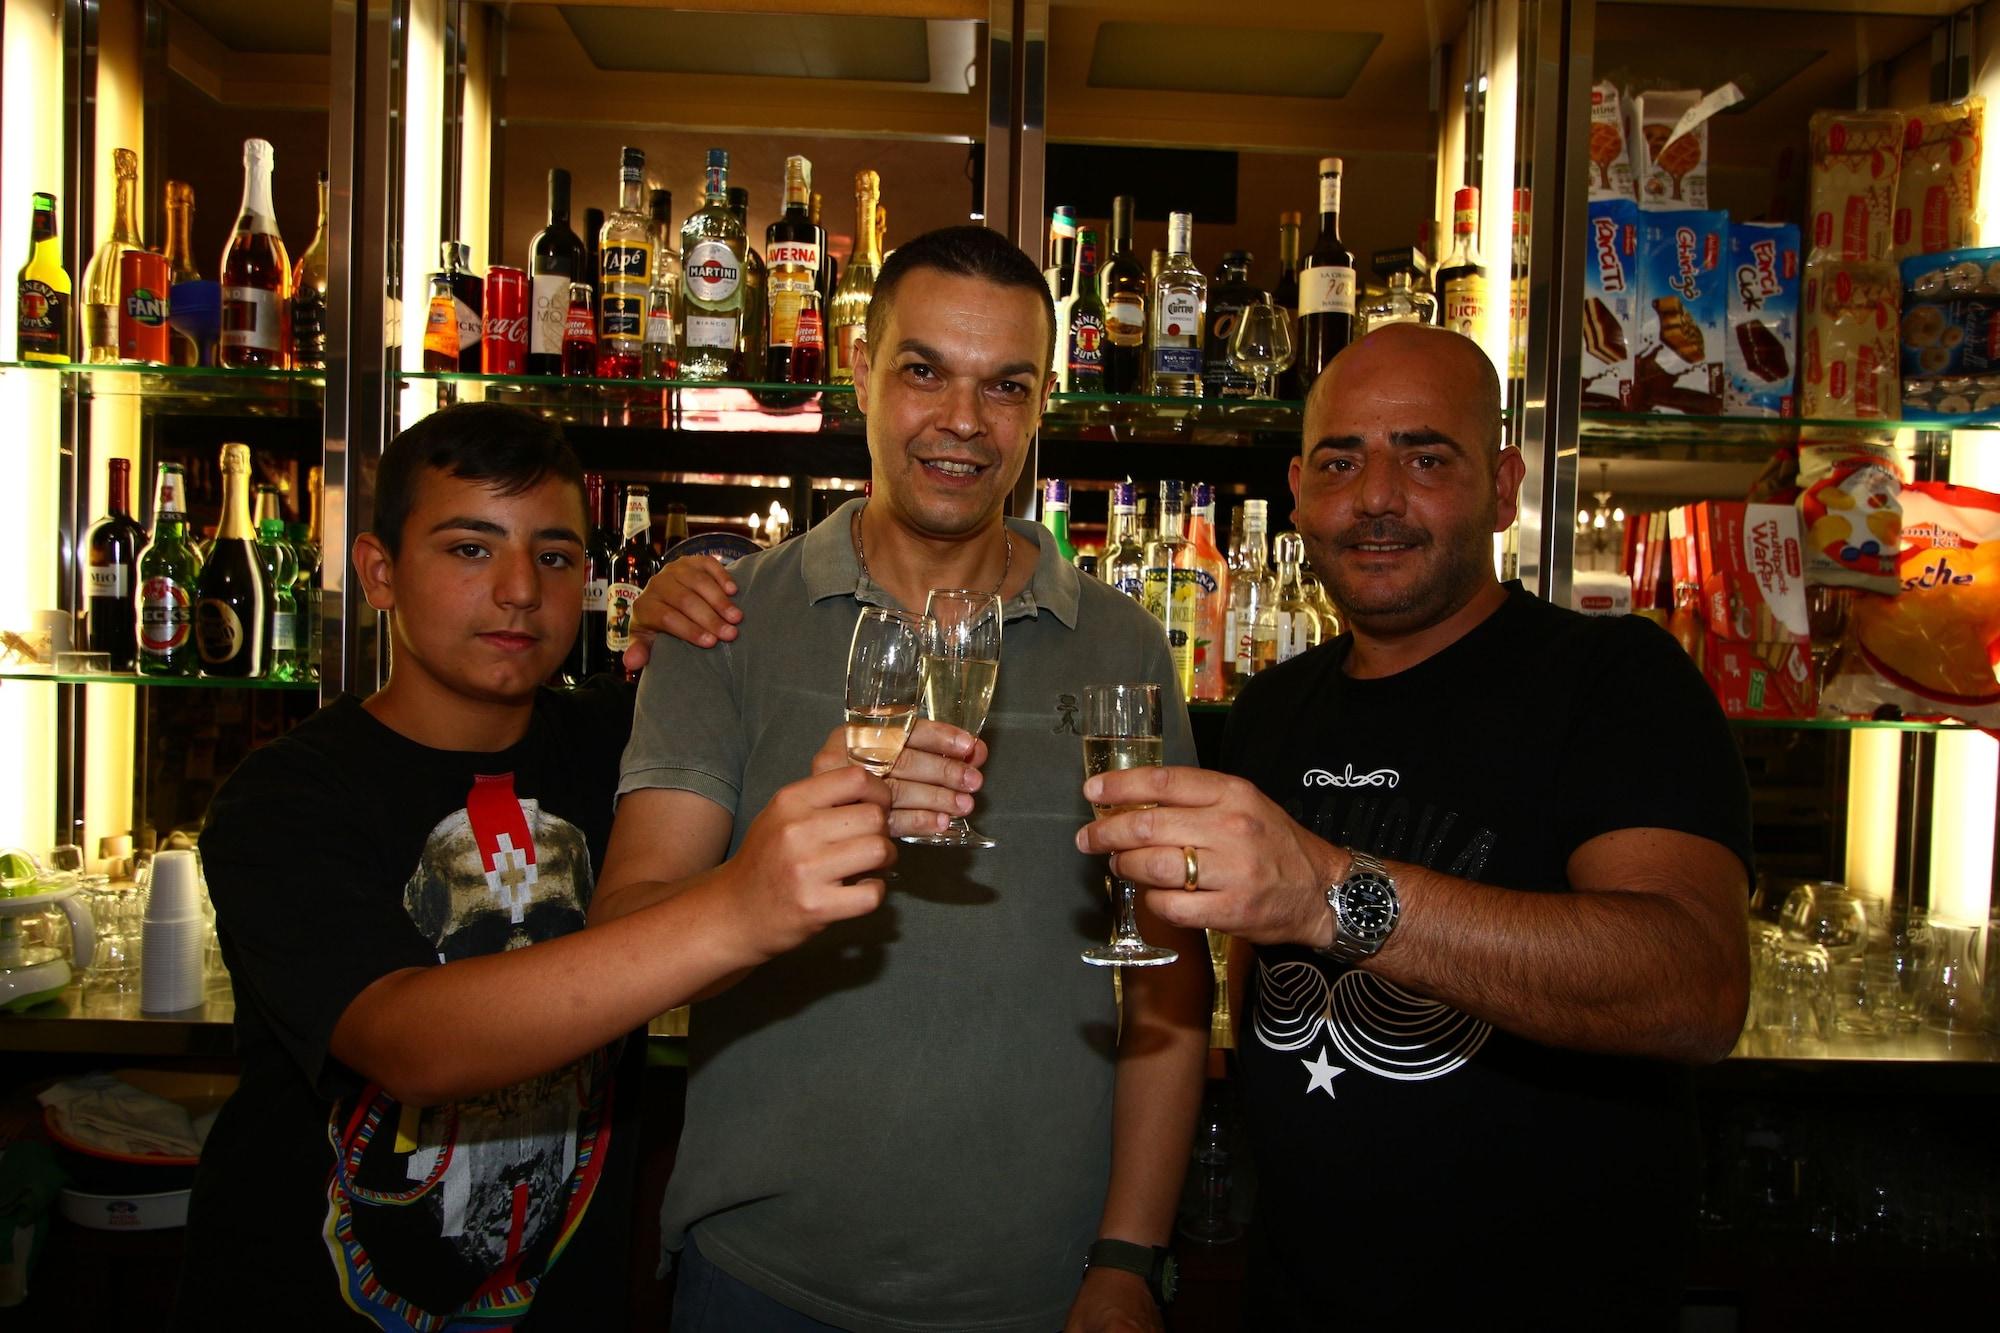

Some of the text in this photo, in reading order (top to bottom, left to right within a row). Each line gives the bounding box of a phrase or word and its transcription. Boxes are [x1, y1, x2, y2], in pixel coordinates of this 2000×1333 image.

[768, 247, 817, 264] AVERNA
[689, 265, 737, 280] MARTINI
[1167, 302, 1194, 315] Cuervo
[567, 320, 586, 330] itter
[695, 320, 727, 328] BIANCO
[1068, 314, 1106, 338] TENNENT'S
[798, 327, 817, 336] itter
[1073, 347, 1102, 361] SUPER
[1751, 521, 1774, 594] Wafer
[1769, 519, 1790, 597] multipack
[1900, 557, 1974, 593] sche
[144, 611, 191, 622] ECK'S
